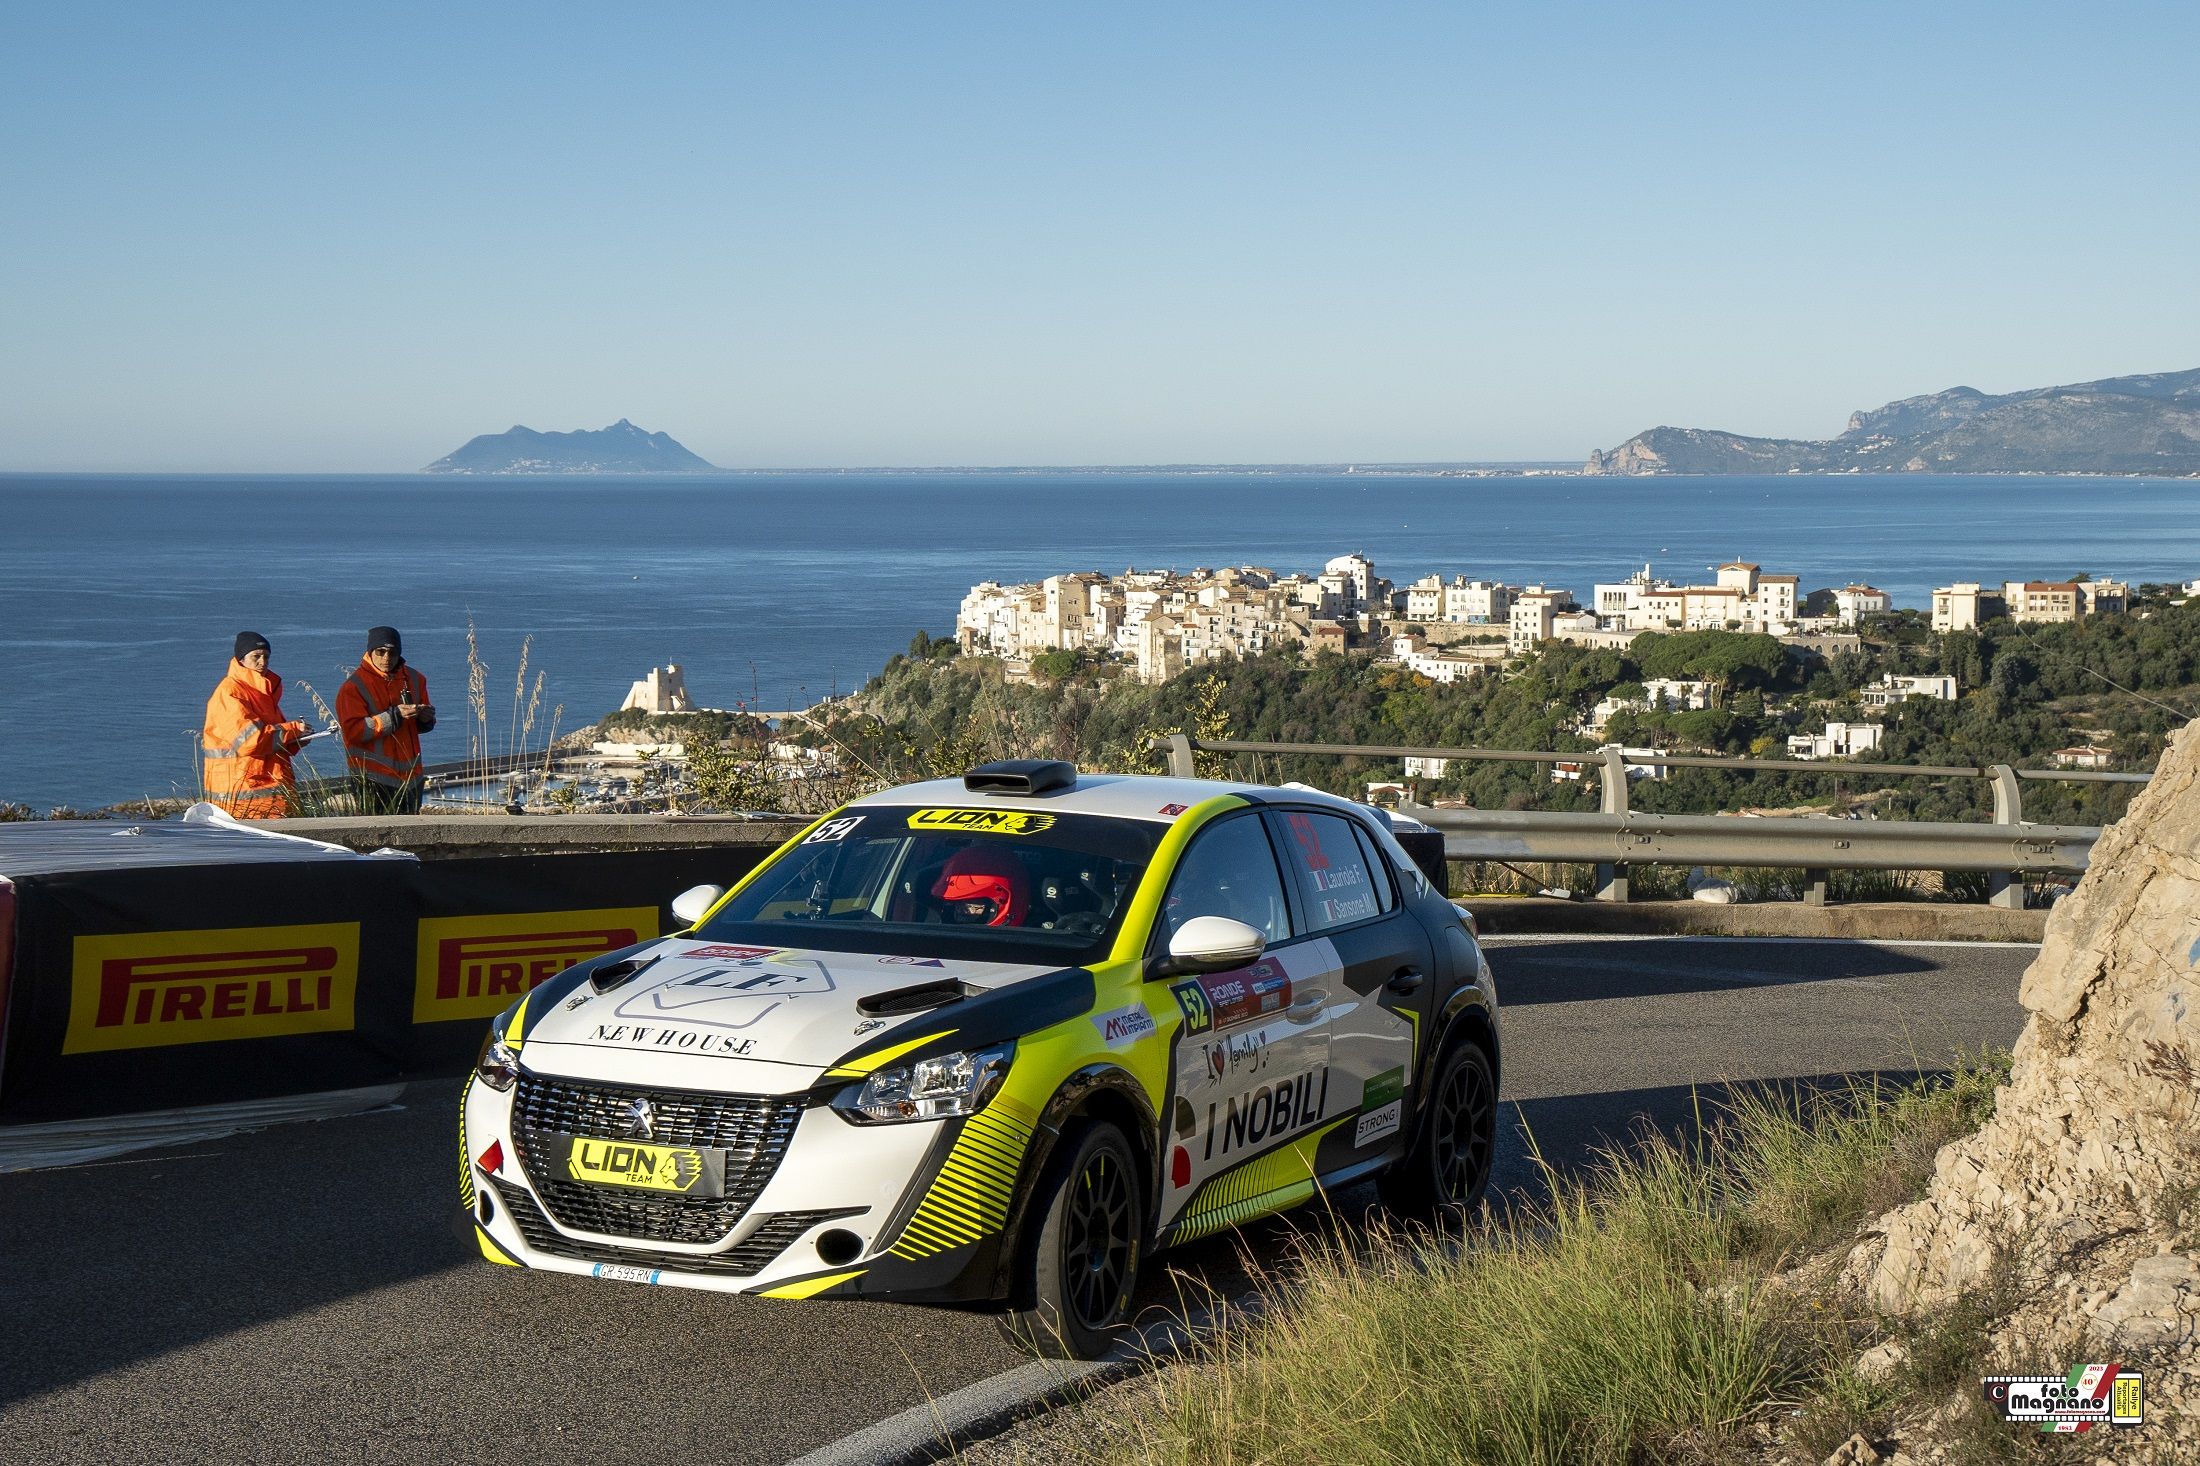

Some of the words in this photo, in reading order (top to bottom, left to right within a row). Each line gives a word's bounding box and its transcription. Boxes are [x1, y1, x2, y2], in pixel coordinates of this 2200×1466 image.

[811, 817, 854, 840] 52
[917, 811, 1009, 825] LION
[1289, 815, 1329, 870] 52
[1334, 897, 1364, 919] Sansone
[95, 946, 338, 1028] PIRELLI
[1209, 981, 1245, 1001] RONDE
[1121, 1011, 1145, 1025] METAL
[1180, 988, 1208, 1030] 52
[588, 1025, 655, 1042] NEW
[654, 1029, 757, 1055] HOUSE
[1204, 1102, 1216, 1161] I
[1222, 1067, 1328, 1154] NOBILI
[1358, 1109, 1395, 1133] STRONG
[581, 1143, 657, 1175] LION
[626, 1174, 652, 1183] TEAM
